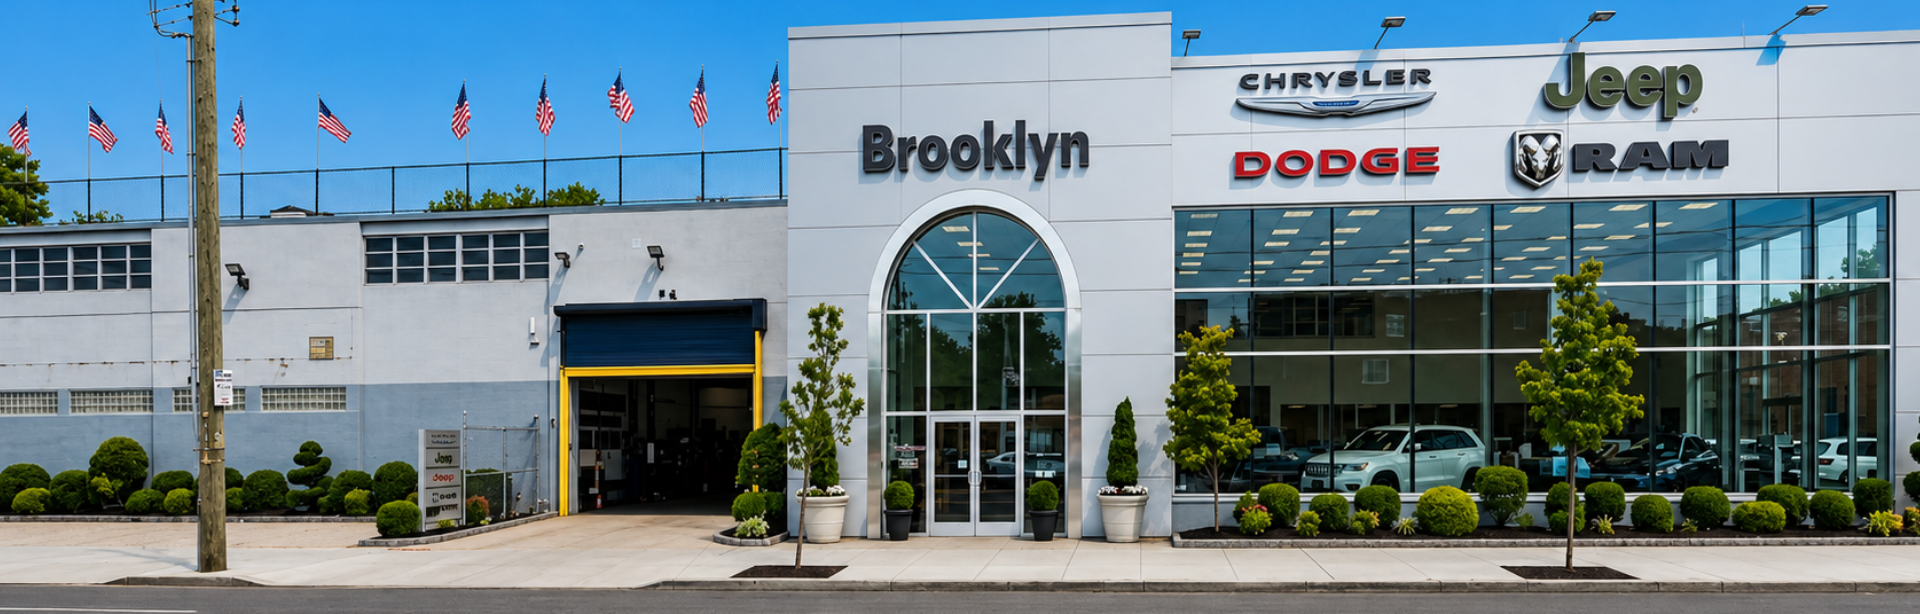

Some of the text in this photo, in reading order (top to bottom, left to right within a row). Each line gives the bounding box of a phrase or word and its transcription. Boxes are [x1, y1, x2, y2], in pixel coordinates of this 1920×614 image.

[1239, 68, 1432, 91] CHRYSLER
[1544, 52, 1704, 119] Jeep
[862, 119, 1089, 181] Brooklyn
[1234, 146, 1440, 179] DODGE
[1572, 139, 1729, 173] RAM
